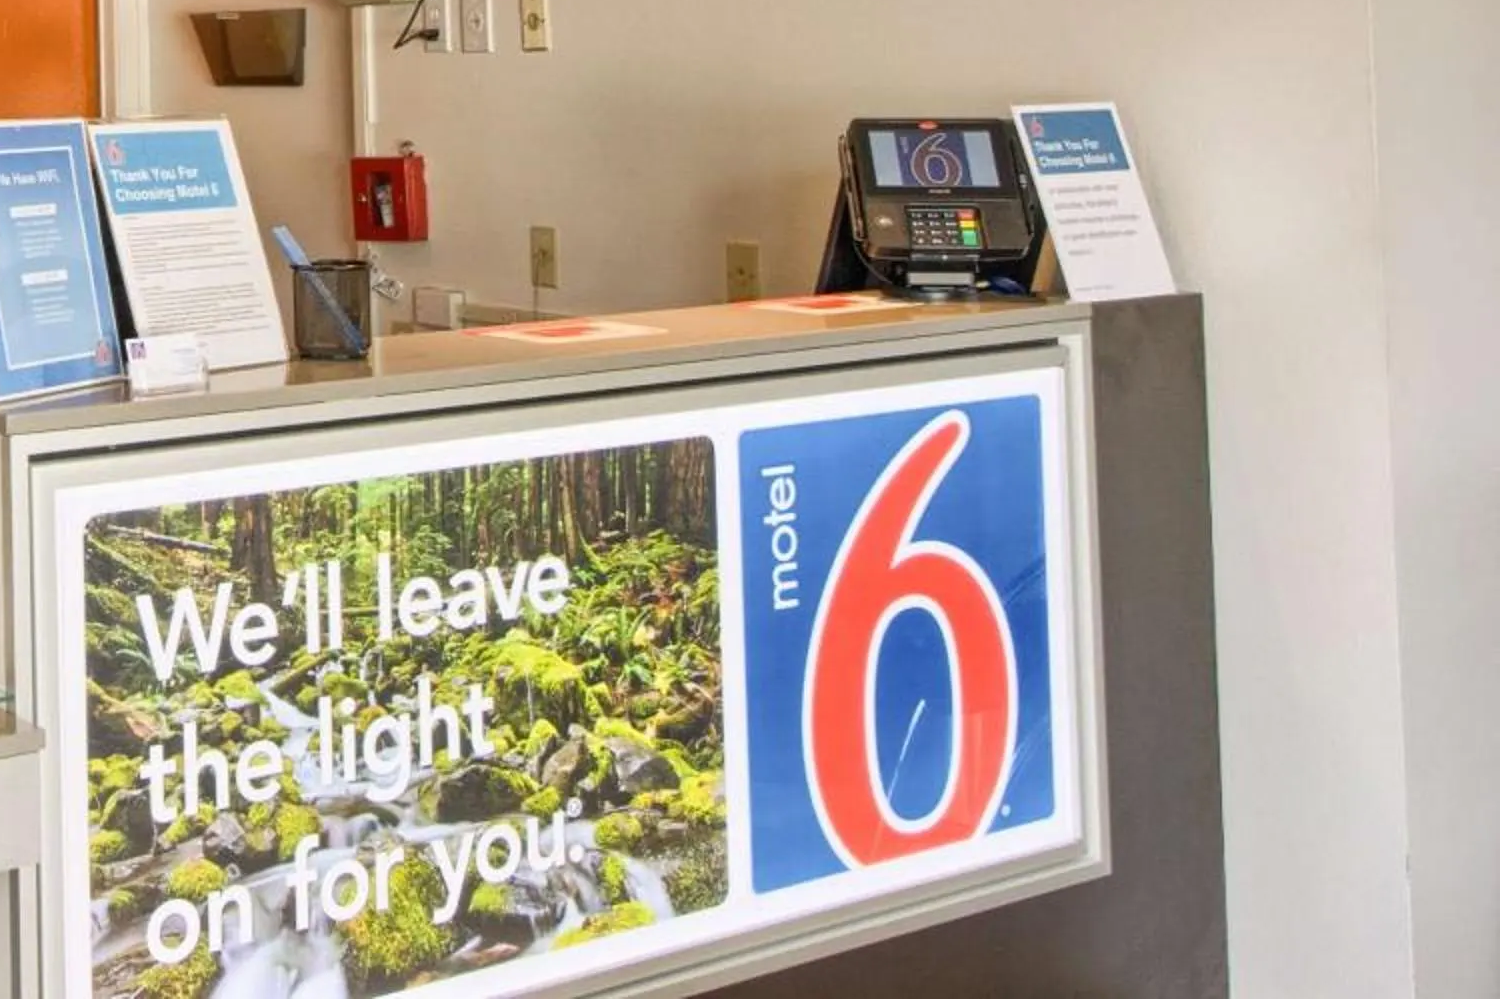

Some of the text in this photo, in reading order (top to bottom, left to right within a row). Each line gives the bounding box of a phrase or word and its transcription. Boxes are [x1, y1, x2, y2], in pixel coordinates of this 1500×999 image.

[110, 164, 199, 183] Thank You For
[115, 185, 177, 202] Choosing
[175, 181, 209, 198] Motel
[910, 132, 963, 186] 6
[762, 464, 799, 611] motel
[135, 552, 570, 682] We'll leave
[802, 409, 1019, 868] 6
[140, 677, 495, 824] the light
[147, 885, 255, 964] on
[285, 833, 405, 931] for
